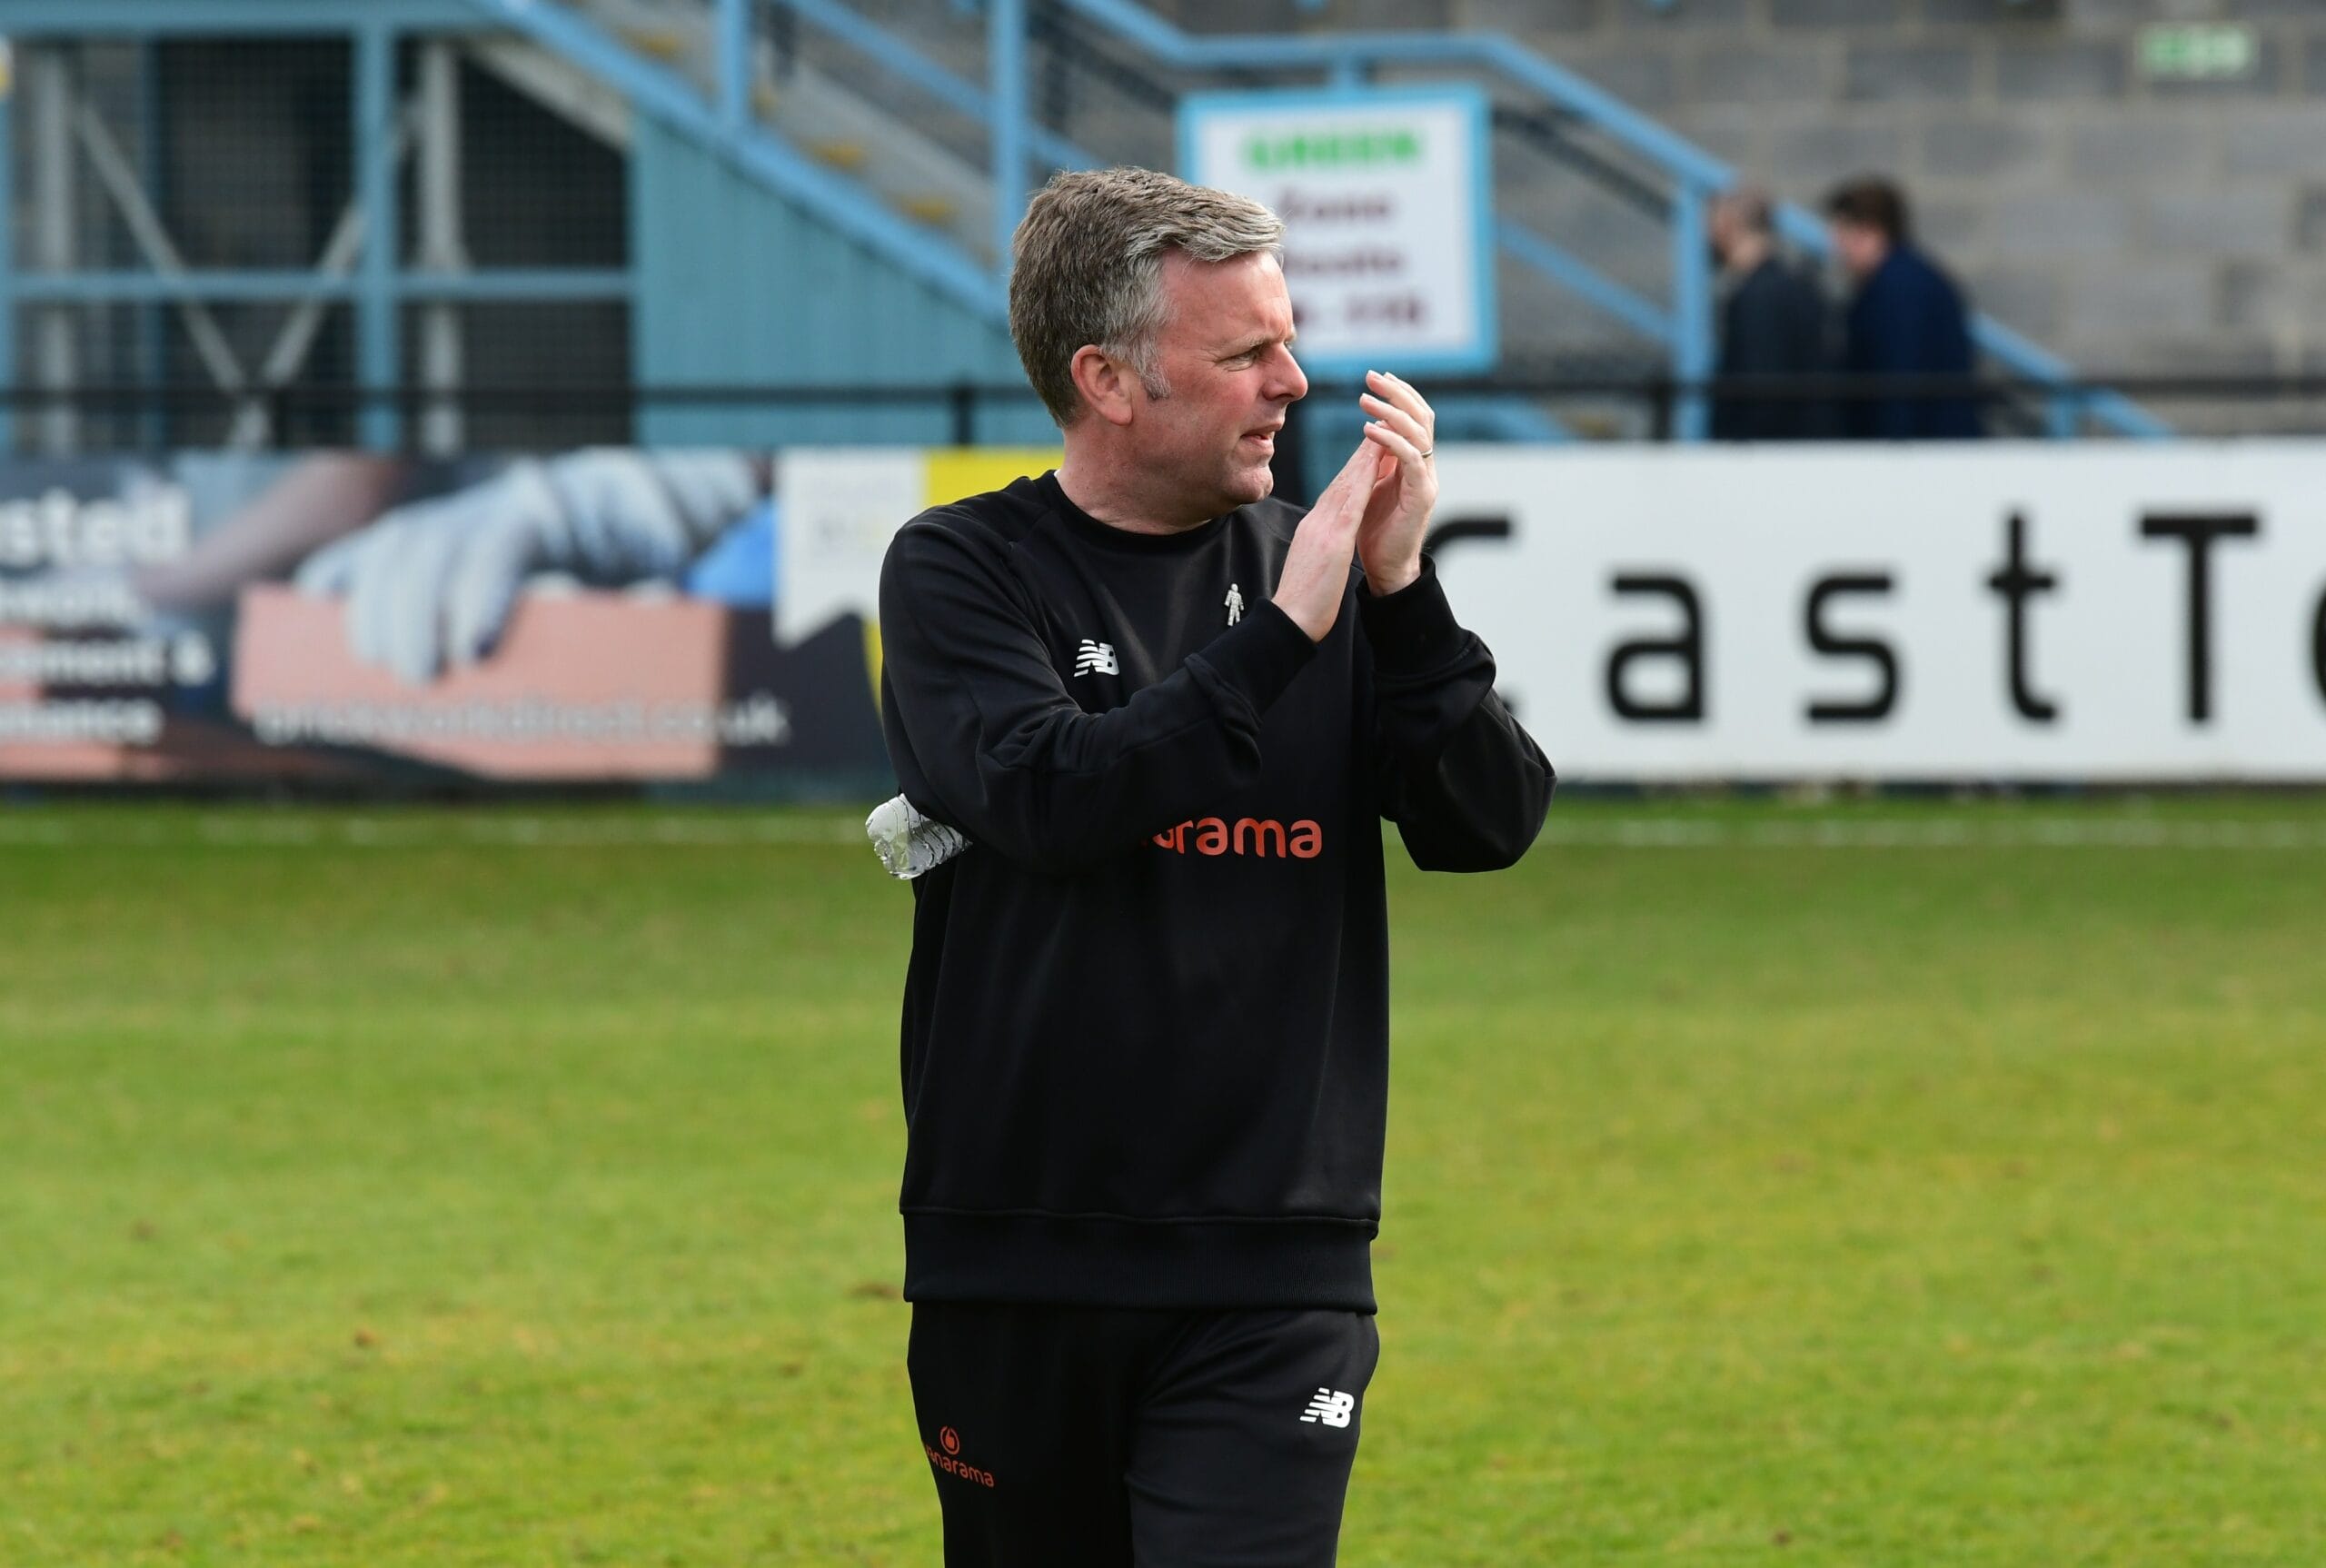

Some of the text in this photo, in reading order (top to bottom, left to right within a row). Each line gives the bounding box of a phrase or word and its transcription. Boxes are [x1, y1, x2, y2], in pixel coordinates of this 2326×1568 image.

[1420, 511, 2326, 723] astT
[0, 639, 164, 681] ement
[0, 703, 159, 741] nance
